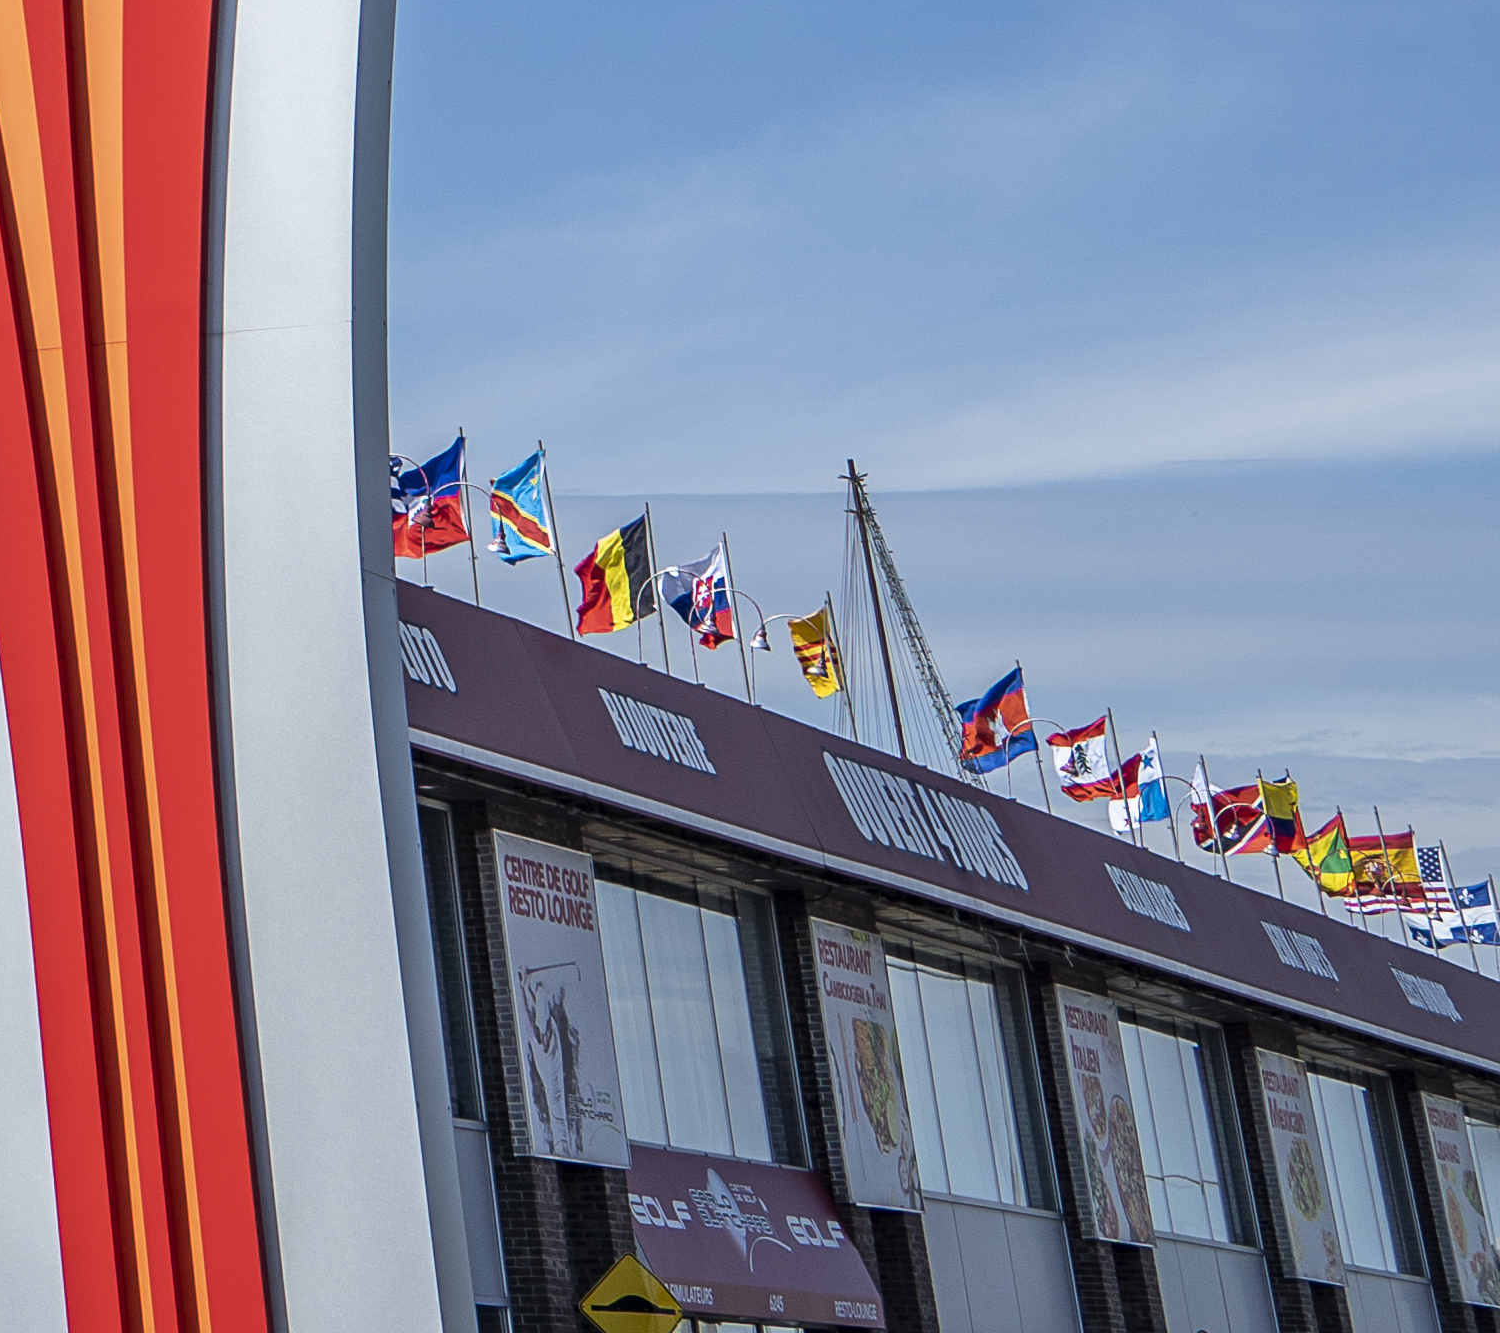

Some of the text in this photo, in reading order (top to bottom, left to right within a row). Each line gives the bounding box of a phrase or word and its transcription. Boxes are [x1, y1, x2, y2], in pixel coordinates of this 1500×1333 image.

[596, 685, 718, 776] BIJOUTERIE
[821, 749, 946, 865] OUVERT
[927, 787, 1030, 893] JOURS
[503, 853, 590, 899] CENTRE DE GOLF
[507, 884, 595, 932] RESTO LOUNGE
[817, 937, 872, 977] RESTAURANT
[1063, 1003, 1109, 1038] RESTAURANT
[1261, 1069, 1301, 1099] RESTAURANT
[627, 1192, 693, 1231] GOLF
[786, 1215, 845, 1249] GOLF
[769, 1294, 785, 1313] 6245
